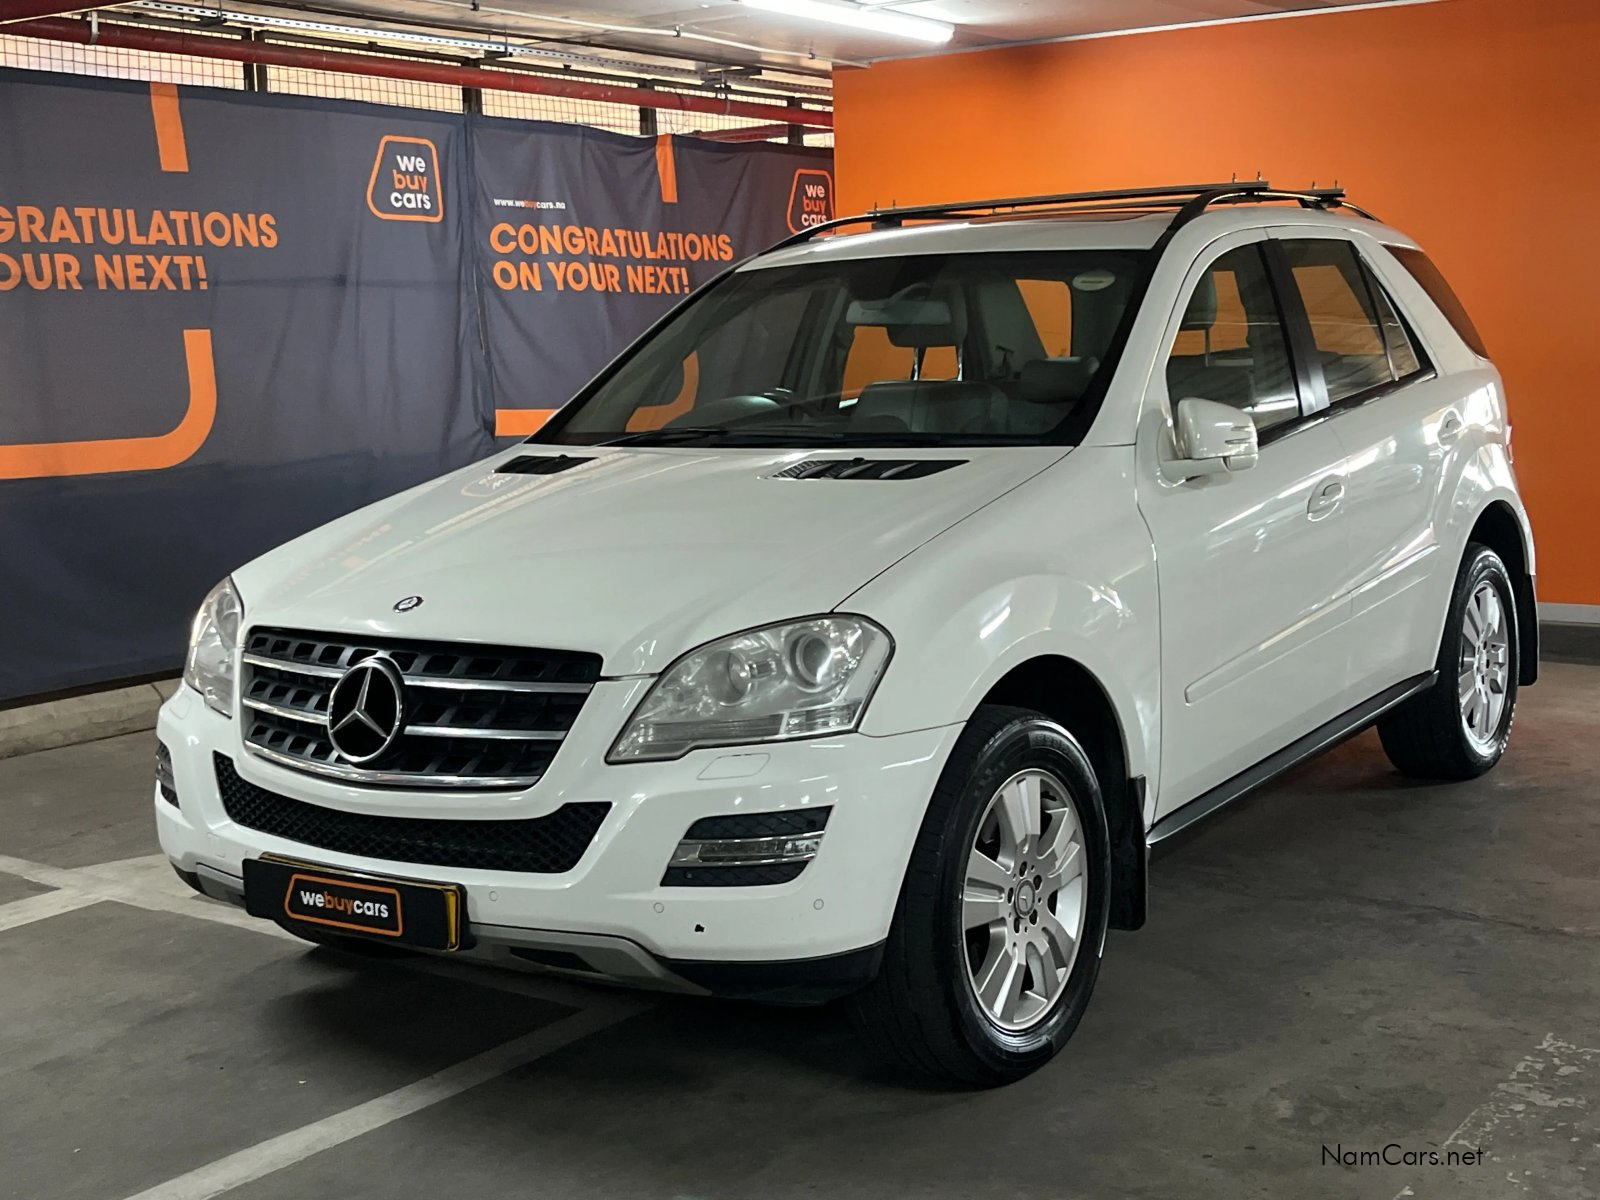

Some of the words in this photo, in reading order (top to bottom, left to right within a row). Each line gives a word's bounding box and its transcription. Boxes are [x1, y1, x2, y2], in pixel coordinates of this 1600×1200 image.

[396, 155, 427, 173] we
[392, 169, 428, 194] buy
[804, 184, 826, 198] we
[390, 192, 432, 210] cars
[493, 198, 566, 210] www.webuycars.na
[802, 195, 827, 215] buy
[490, 223, 733, 261] CONGRATULATIONS
[94, 254, 208, 290] NEXT!
[493, 260, 542, 291] ON
[546, 261, 622, 293] YOUR
[626, 265, 690, 295] NEXT!
[301, 890, 389, 918] webuycars
